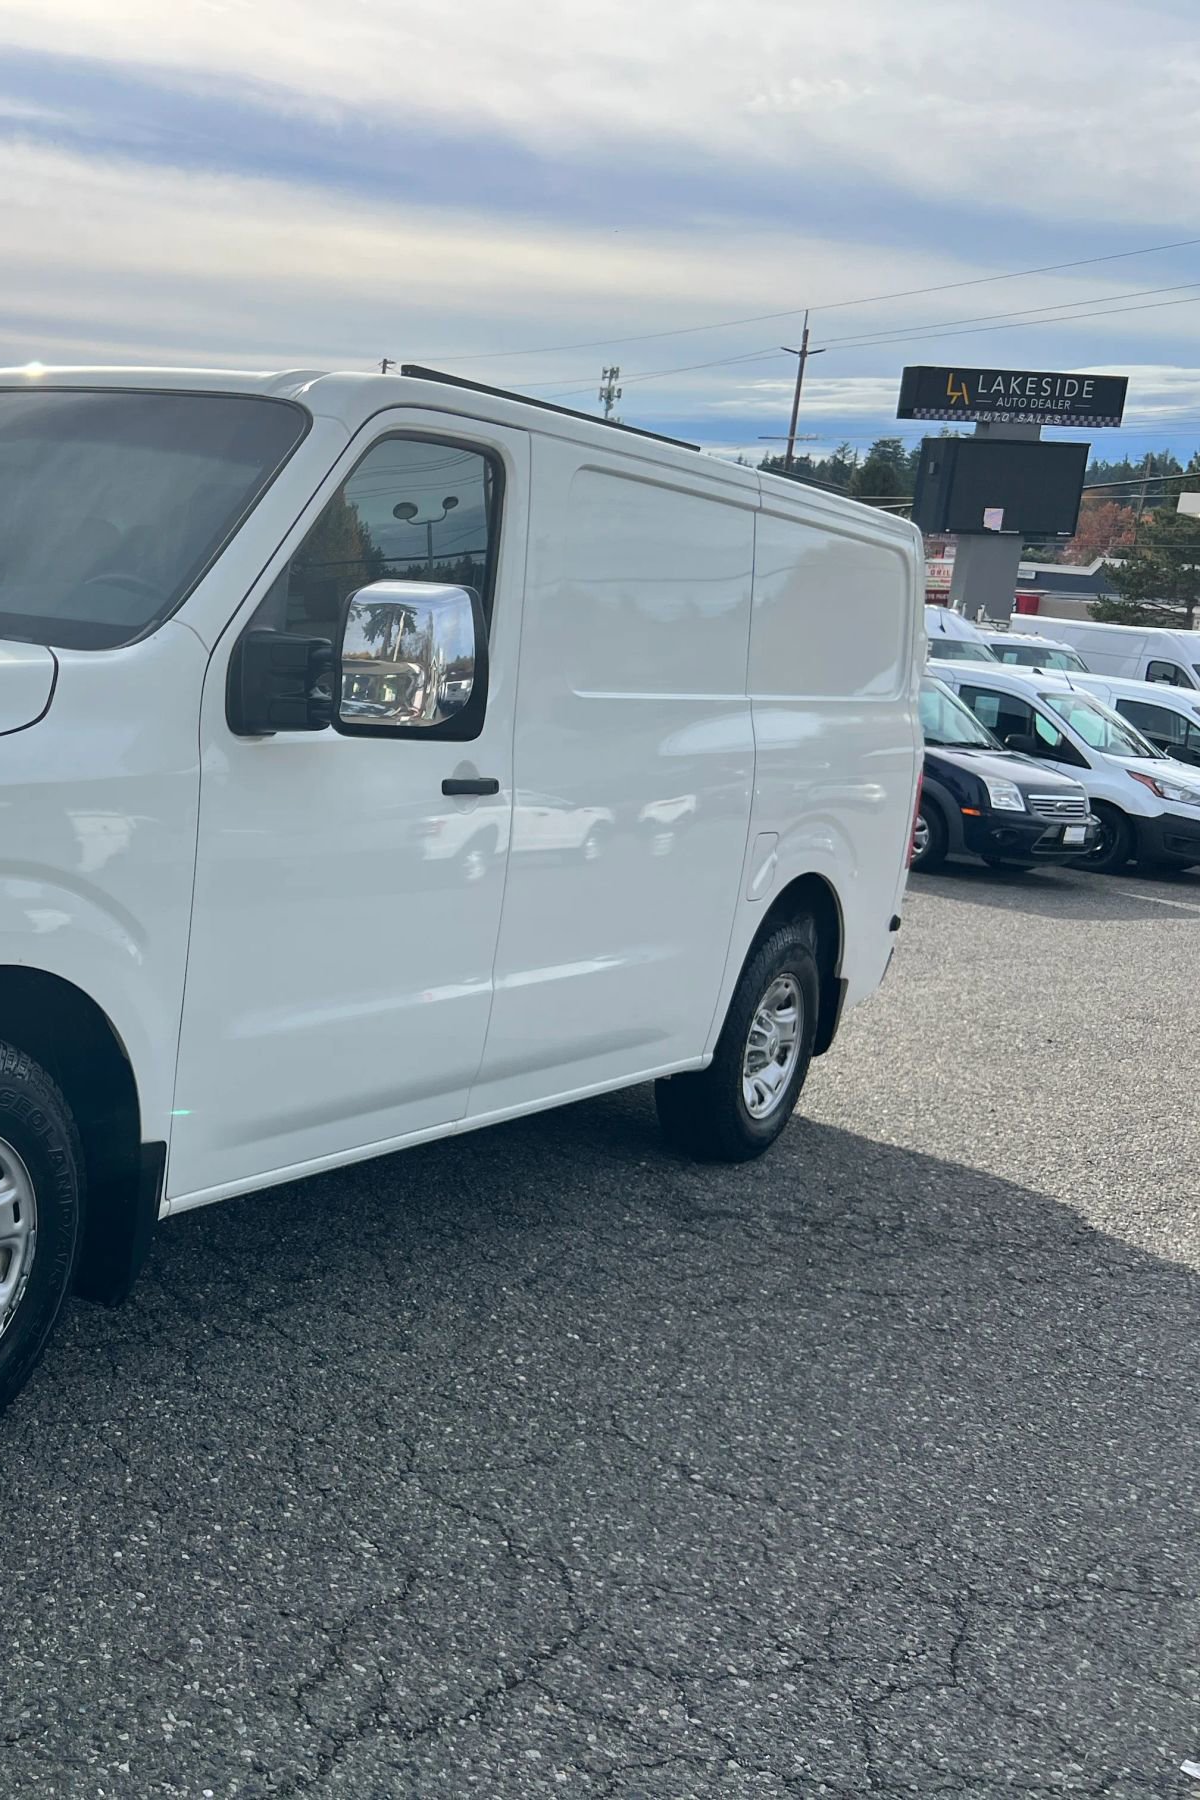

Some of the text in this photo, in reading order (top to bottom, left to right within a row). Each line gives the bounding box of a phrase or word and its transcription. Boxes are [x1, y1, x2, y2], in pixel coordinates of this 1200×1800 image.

[978, 375, 1095, 398] LAKESIDE
[996, 397, 1071, 410] AUTO DEALER
[974, 412, 1061, 424] AUTO SALES
